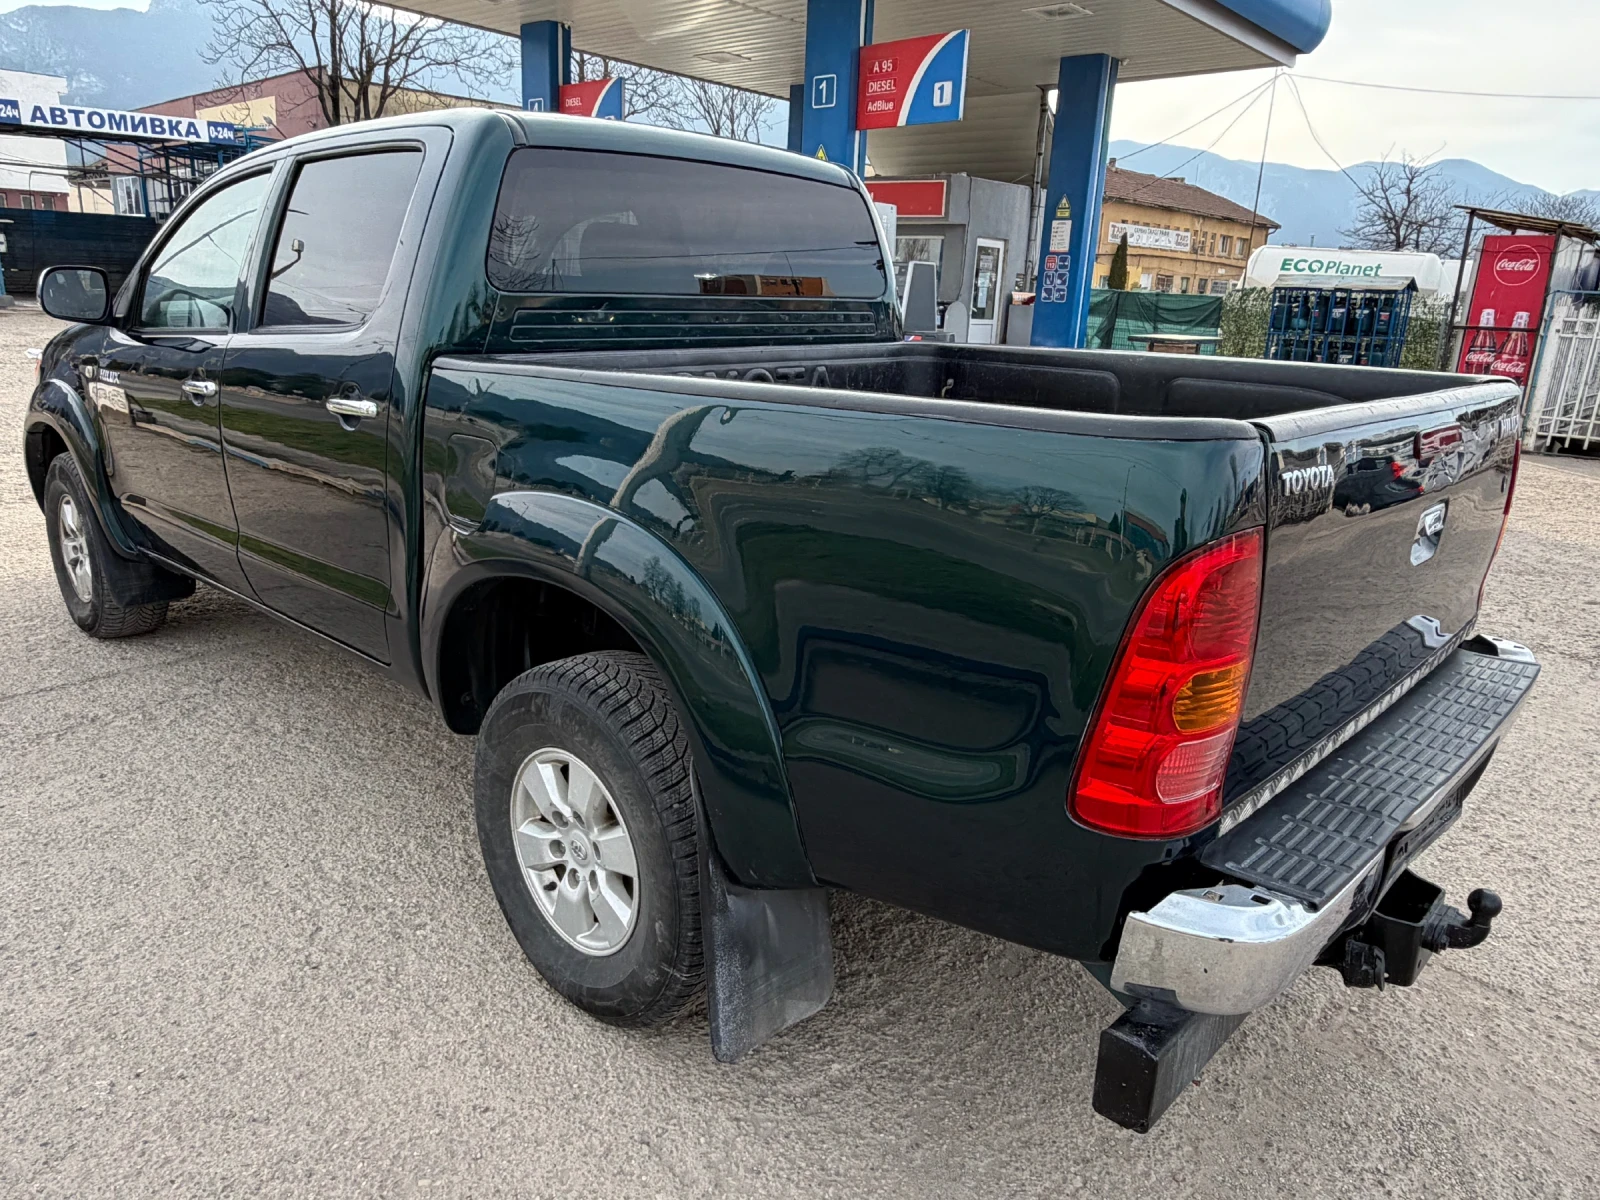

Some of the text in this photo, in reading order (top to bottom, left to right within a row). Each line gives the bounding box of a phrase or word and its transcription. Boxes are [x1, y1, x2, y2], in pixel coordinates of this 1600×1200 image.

[873, 59, 893, 73] A 95
[819, 80, 827, 104] 1
[868, 79, 896, 93] DIESEL
[937, 84, 945, 104] 1
[565, 97, 582, 107] DIESEL
[867, 101, 894, 112] AdBlue
[30, 105, 202, 139] АВТОМИВКА
[1281, 464, 1335, 497] TOYOTA
